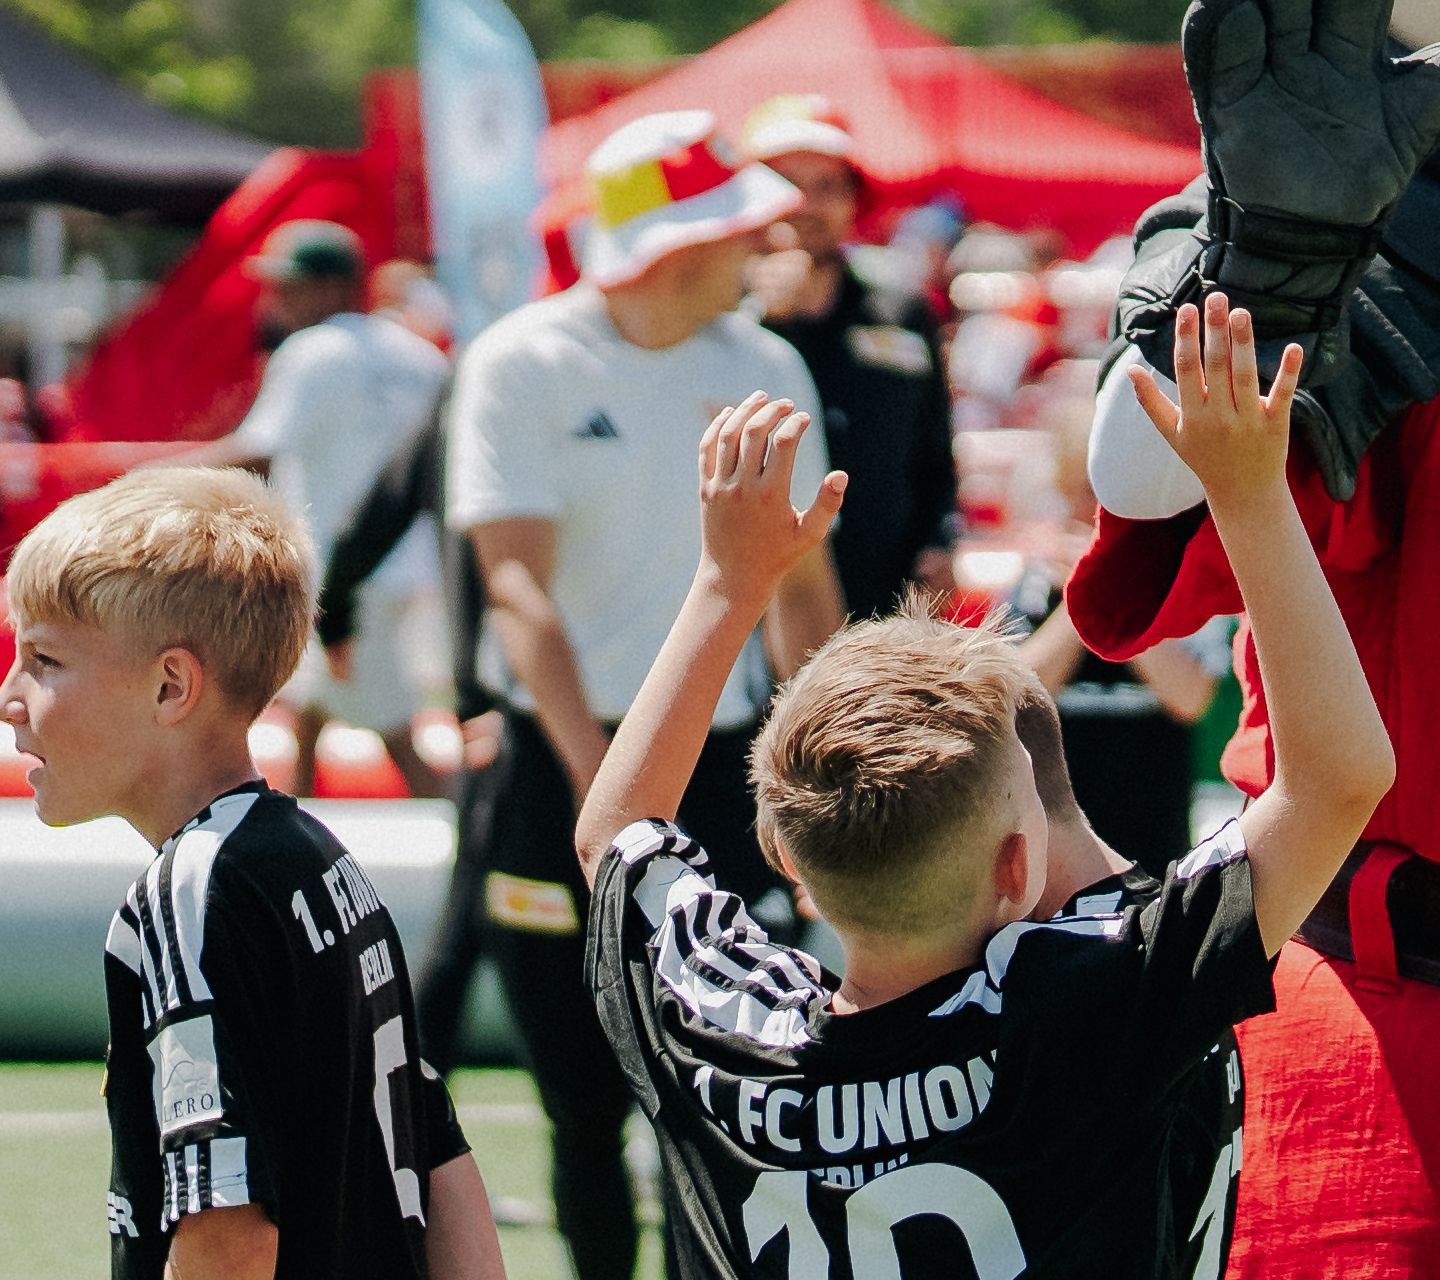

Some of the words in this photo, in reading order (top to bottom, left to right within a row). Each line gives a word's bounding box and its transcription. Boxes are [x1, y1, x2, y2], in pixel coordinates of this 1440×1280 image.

[291, 888, 336, 955] 1.
[163, 1092, 215, 1123] LERO
[738, 1078, 805, 1143] FC
[816, 1048, 998, 1164] UNION
